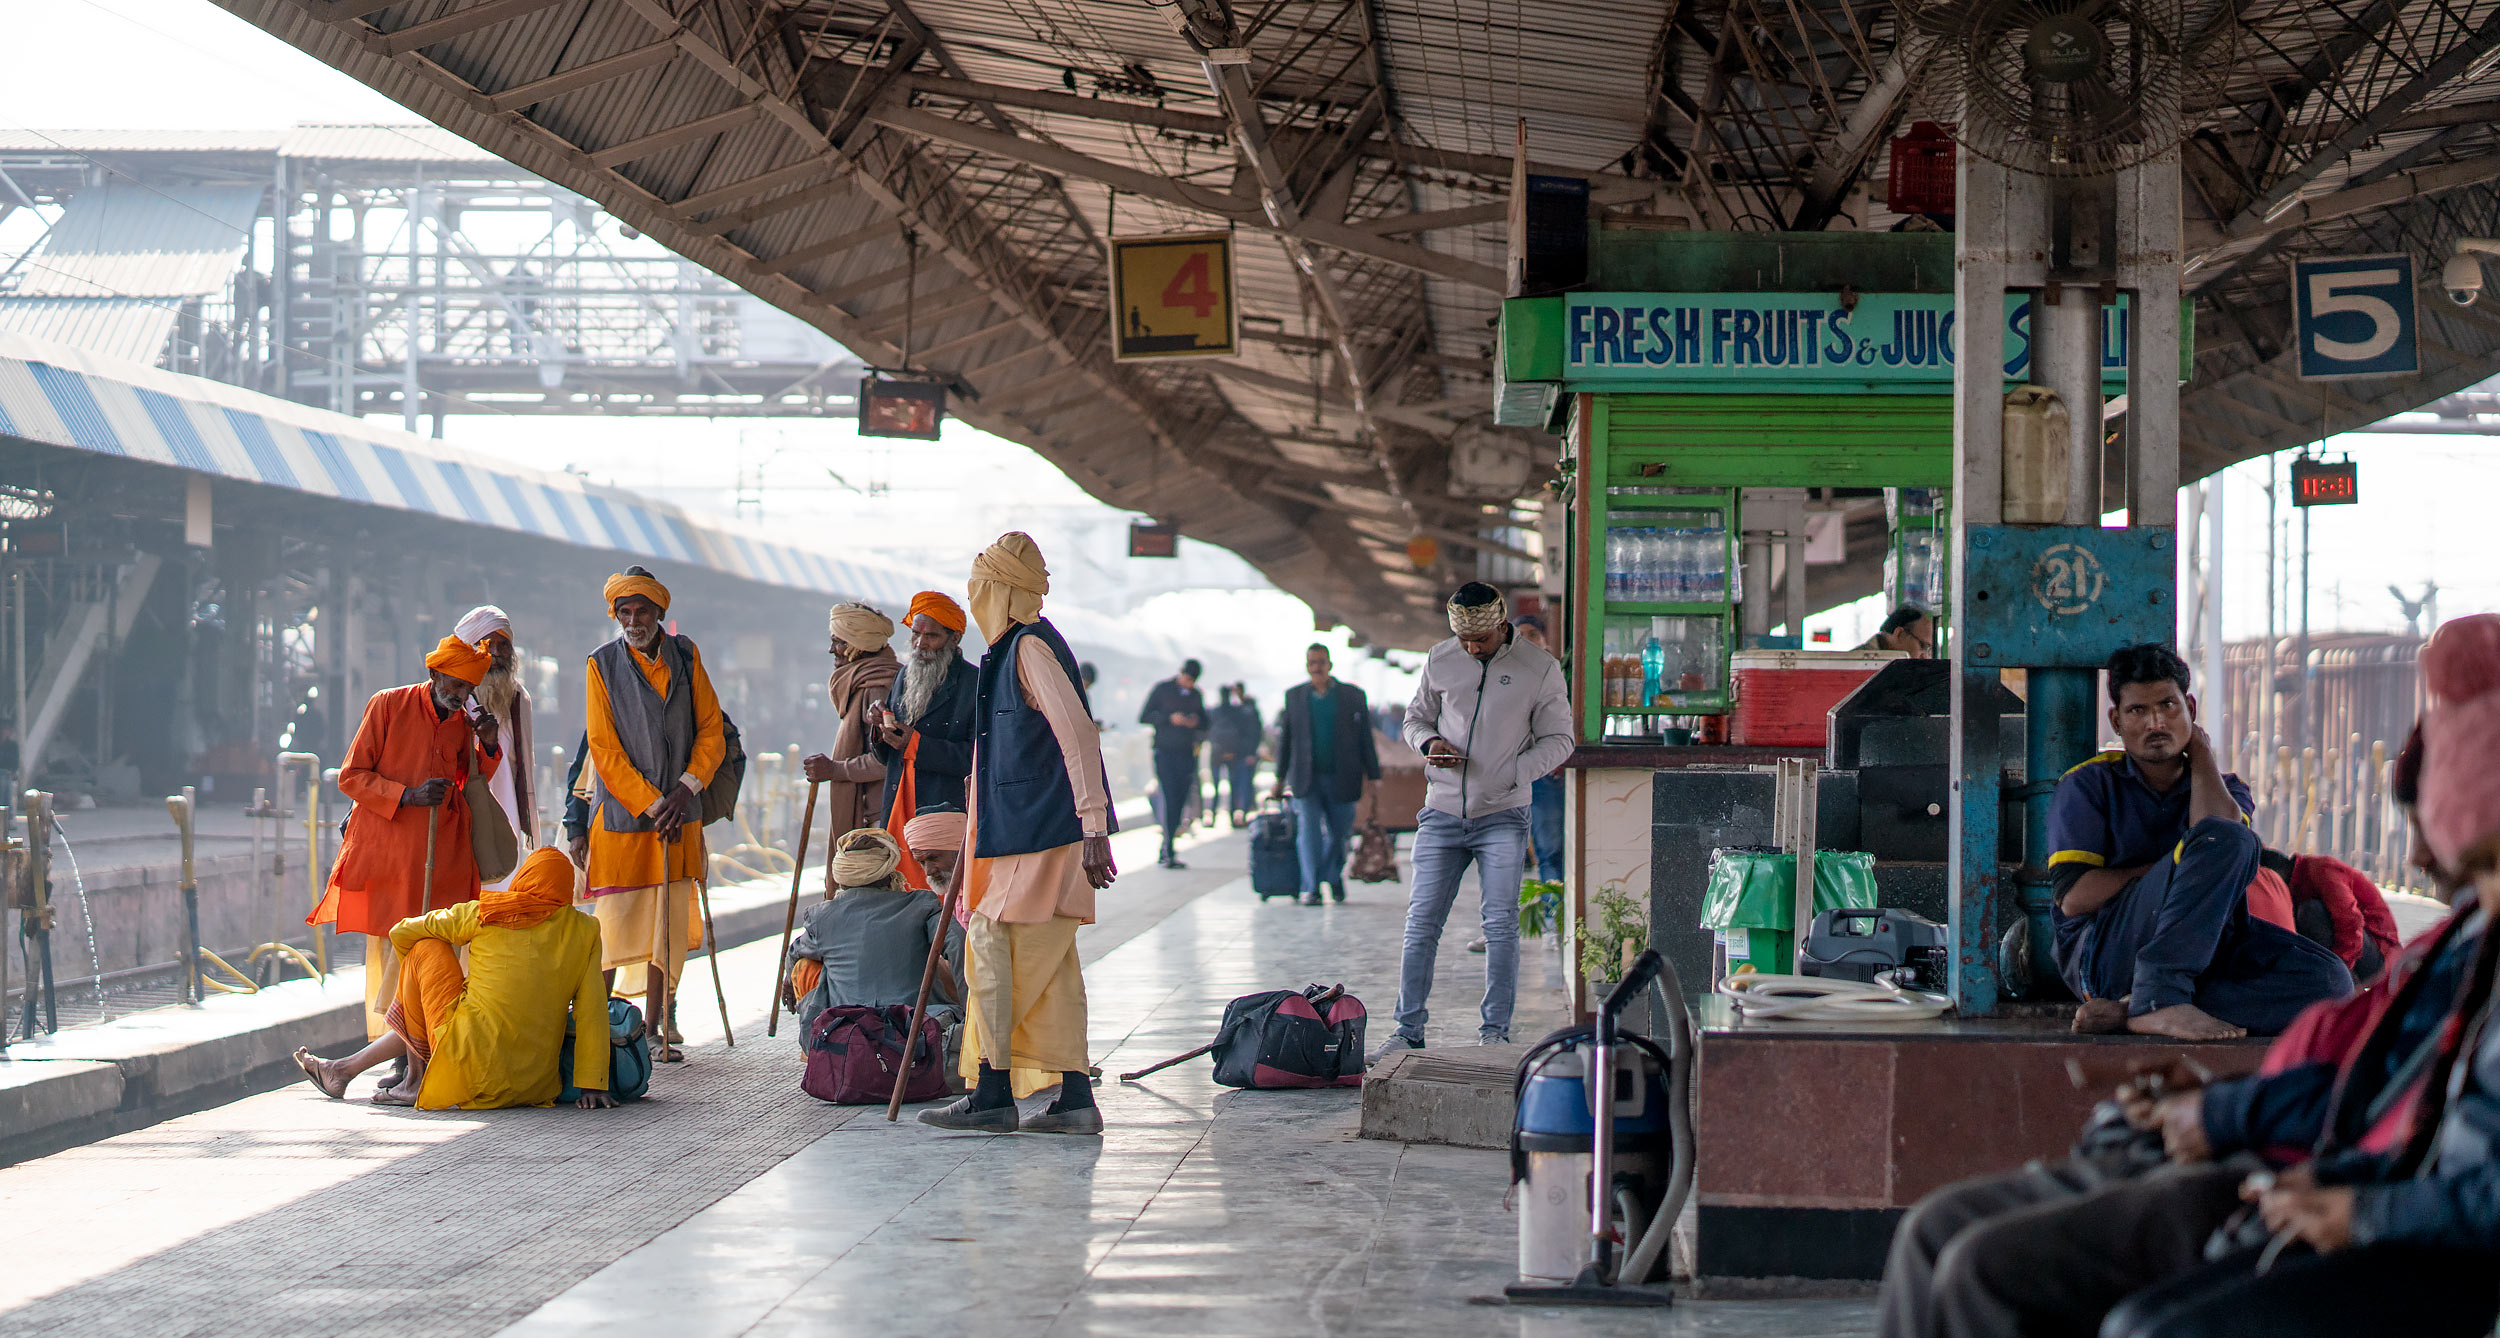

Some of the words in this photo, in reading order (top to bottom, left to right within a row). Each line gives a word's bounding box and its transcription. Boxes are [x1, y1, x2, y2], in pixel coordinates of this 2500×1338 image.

[1161, 252, 1219, 318] 4
[2308, 268, 2401, 361] 5
[1570, 305, 1704, 367] FRESH
[1711, 308, 1855, 367] FRUITS
[1855, 337, 1878, 368] &
[1881, 309, 1954, 368] JUIC
[2045, 555, 2087, 598] 21
